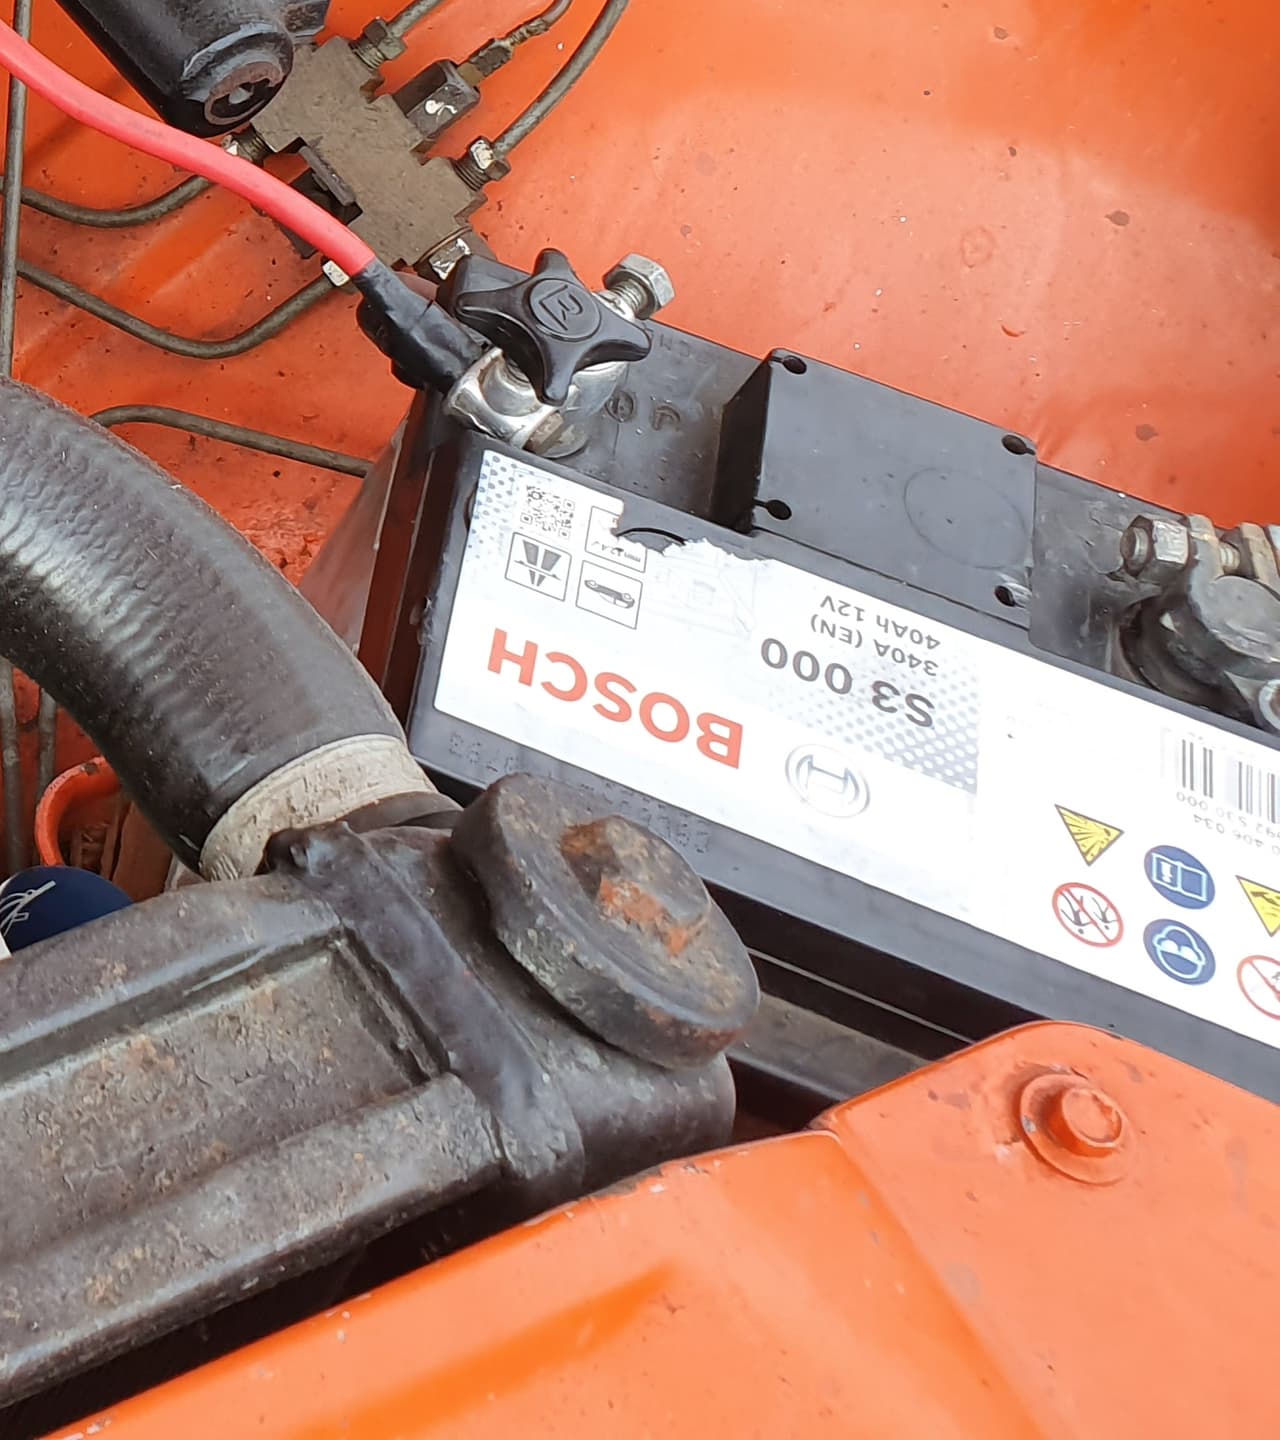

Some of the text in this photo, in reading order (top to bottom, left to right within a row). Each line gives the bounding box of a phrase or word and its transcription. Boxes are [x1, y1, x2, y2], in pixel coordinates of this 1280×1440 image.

[810, 613, 939, 677] 340A (EN)
[820, 595, 941, 650] 40Ah 12V
[487, 627, 744, 769] BOSCH
[761, 637, 936, 728] S3 000
[1176, 790, 1209, 811] 000
[1193, 813, 1225, 835] 034
